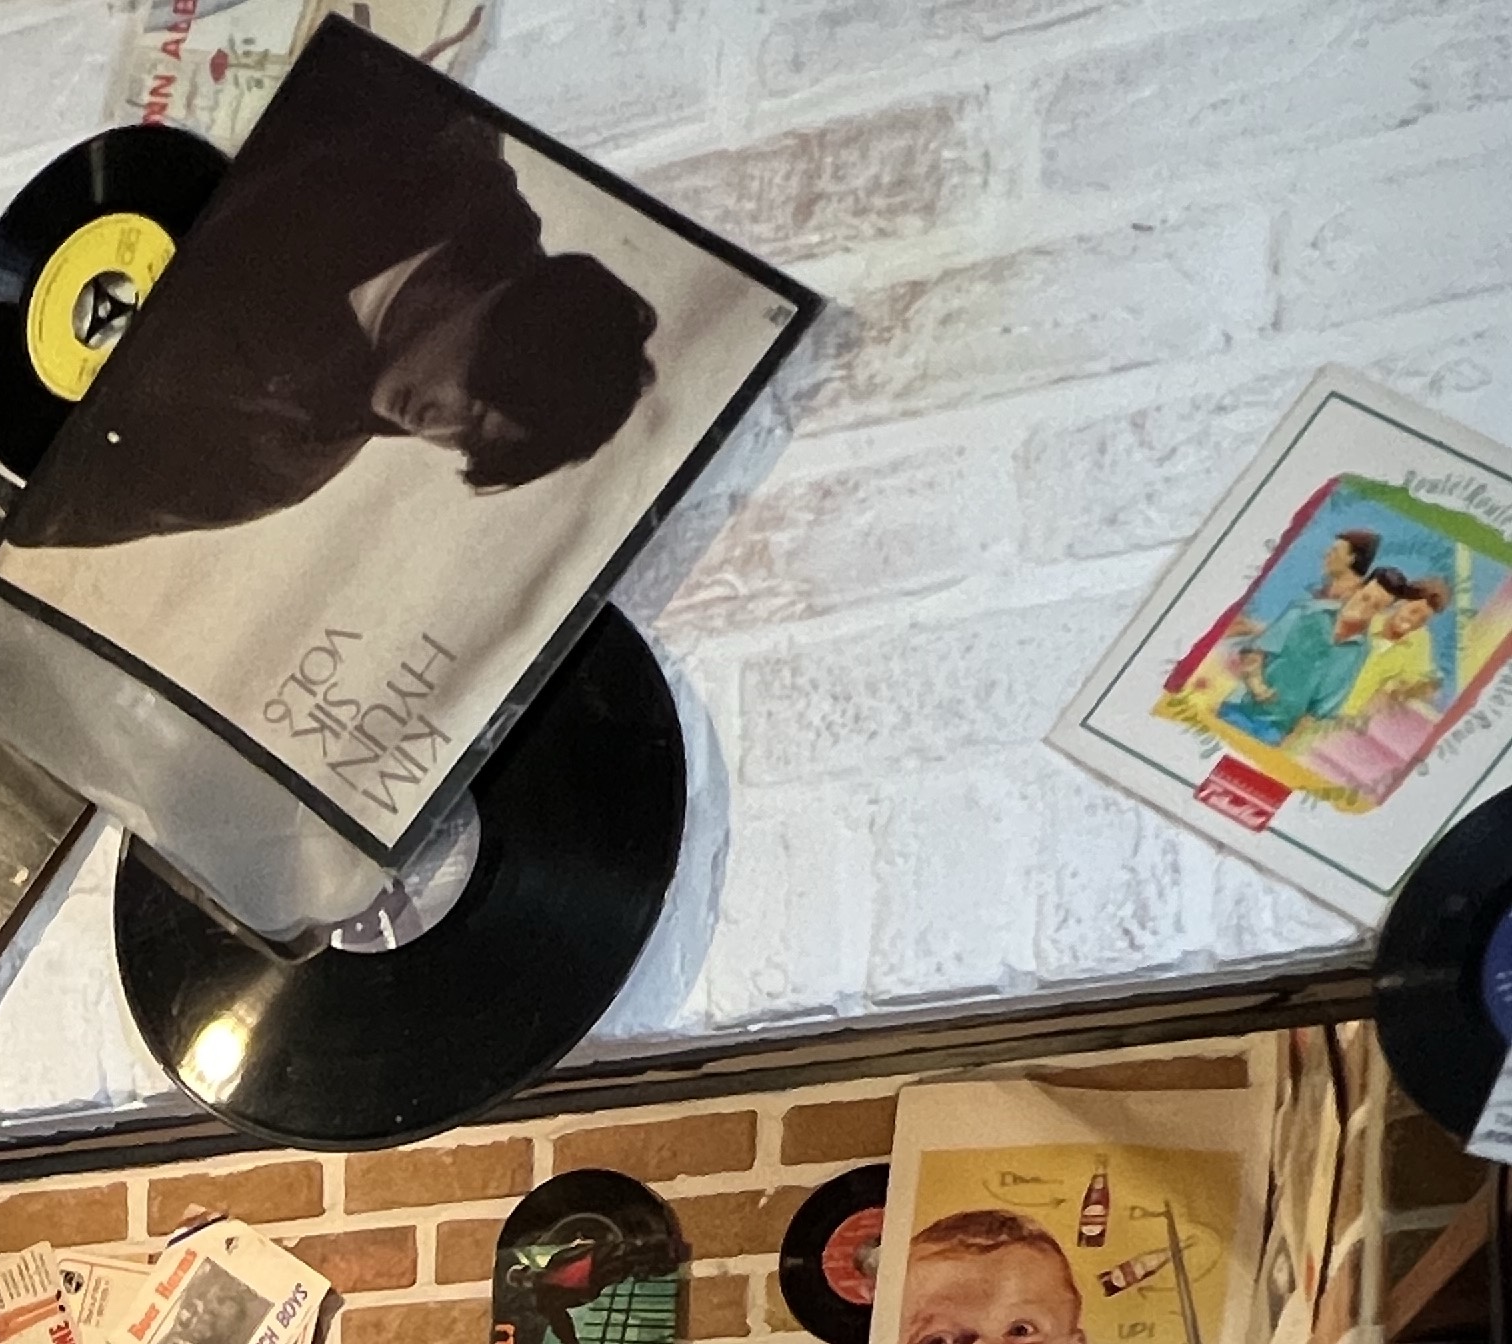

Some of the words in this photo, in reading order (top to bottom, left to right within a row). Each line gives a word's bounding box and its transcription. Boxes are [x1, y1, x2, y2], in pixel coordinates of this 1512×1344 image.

[291, 681, 361, 758] SIK
[326, 632, 457, 792] HYUN
[361, 714, 452, 815] KIM
[276, 1282, 309, 1329] BOYS
